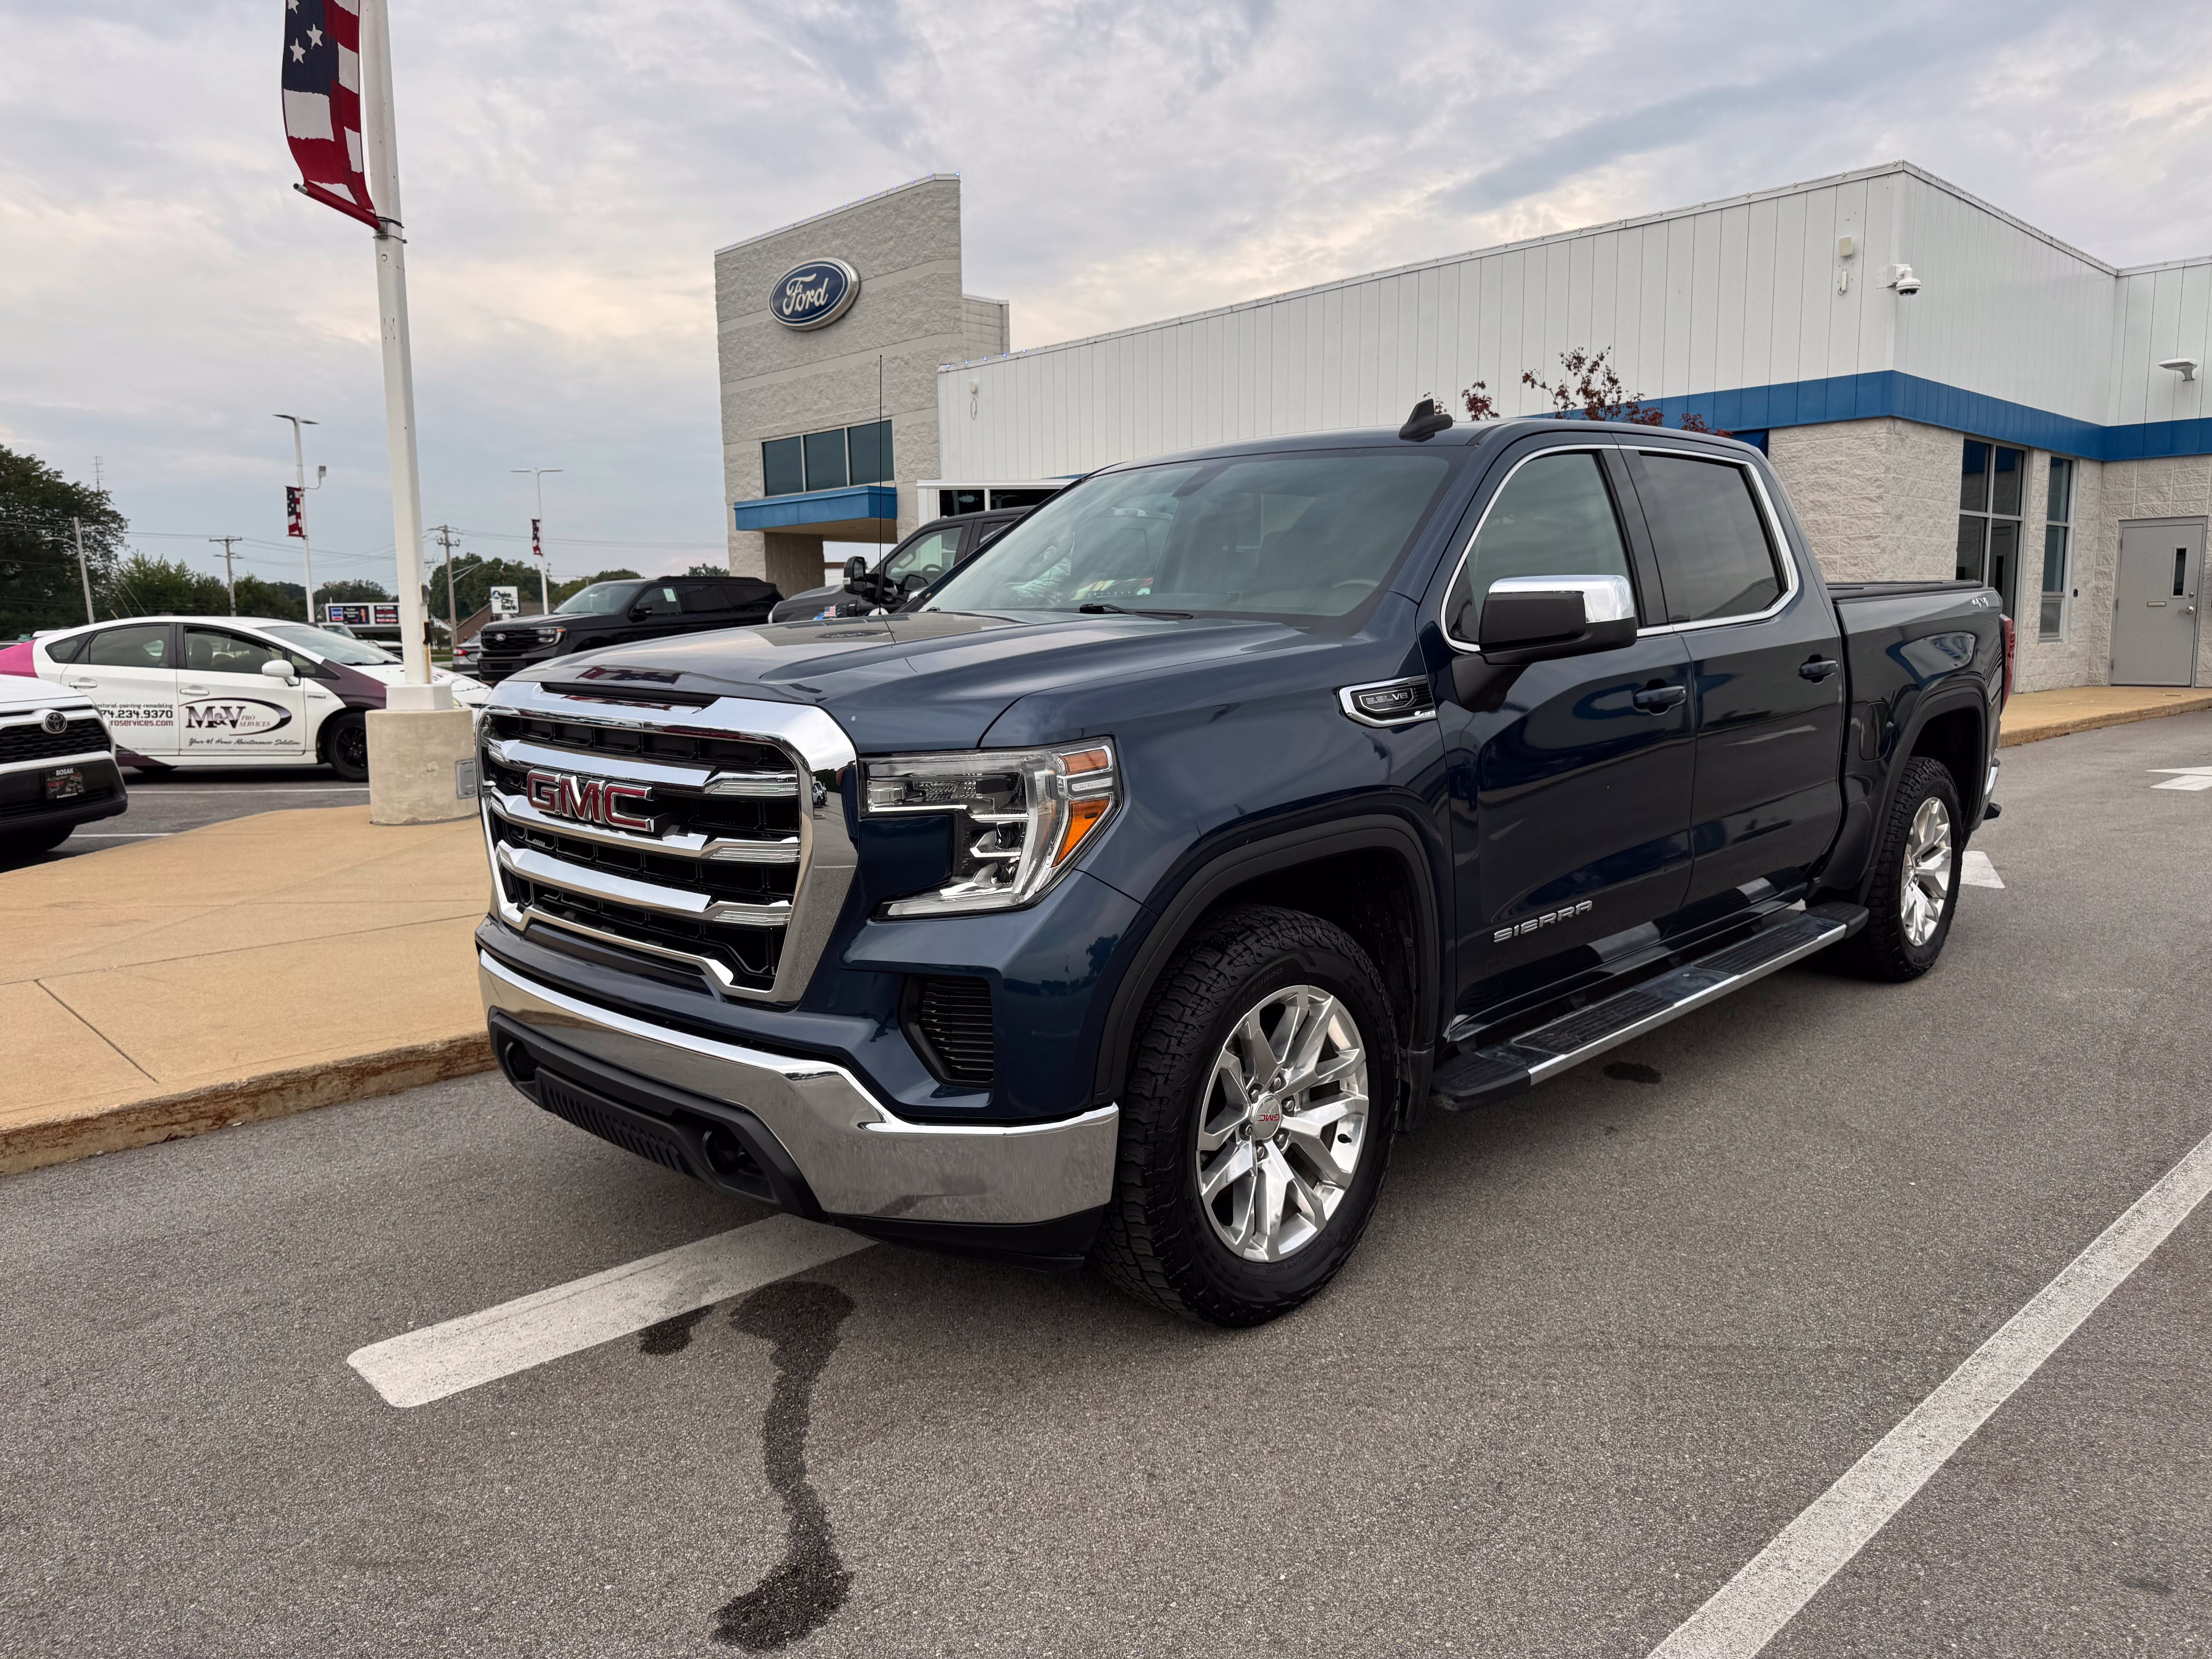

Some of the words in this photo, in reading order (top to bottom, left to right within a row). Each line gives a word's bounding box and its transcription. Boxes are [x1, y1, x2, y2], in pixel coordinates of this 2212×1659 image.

[783, 273, 829, 316] Ford
[501, 597, 514, 605] City
[100, 709, 173, 719] 74.234.9370
[185, 706, 246, 728] M&V
[189, 737, 204, 746] Your
[56, 768, 74, 776] BOSAK
[527, 768, 654, 833] GMC
[1493, 900, 1593, 943] SIERRA
[1344, 971, 1390, 1062] COOPER
